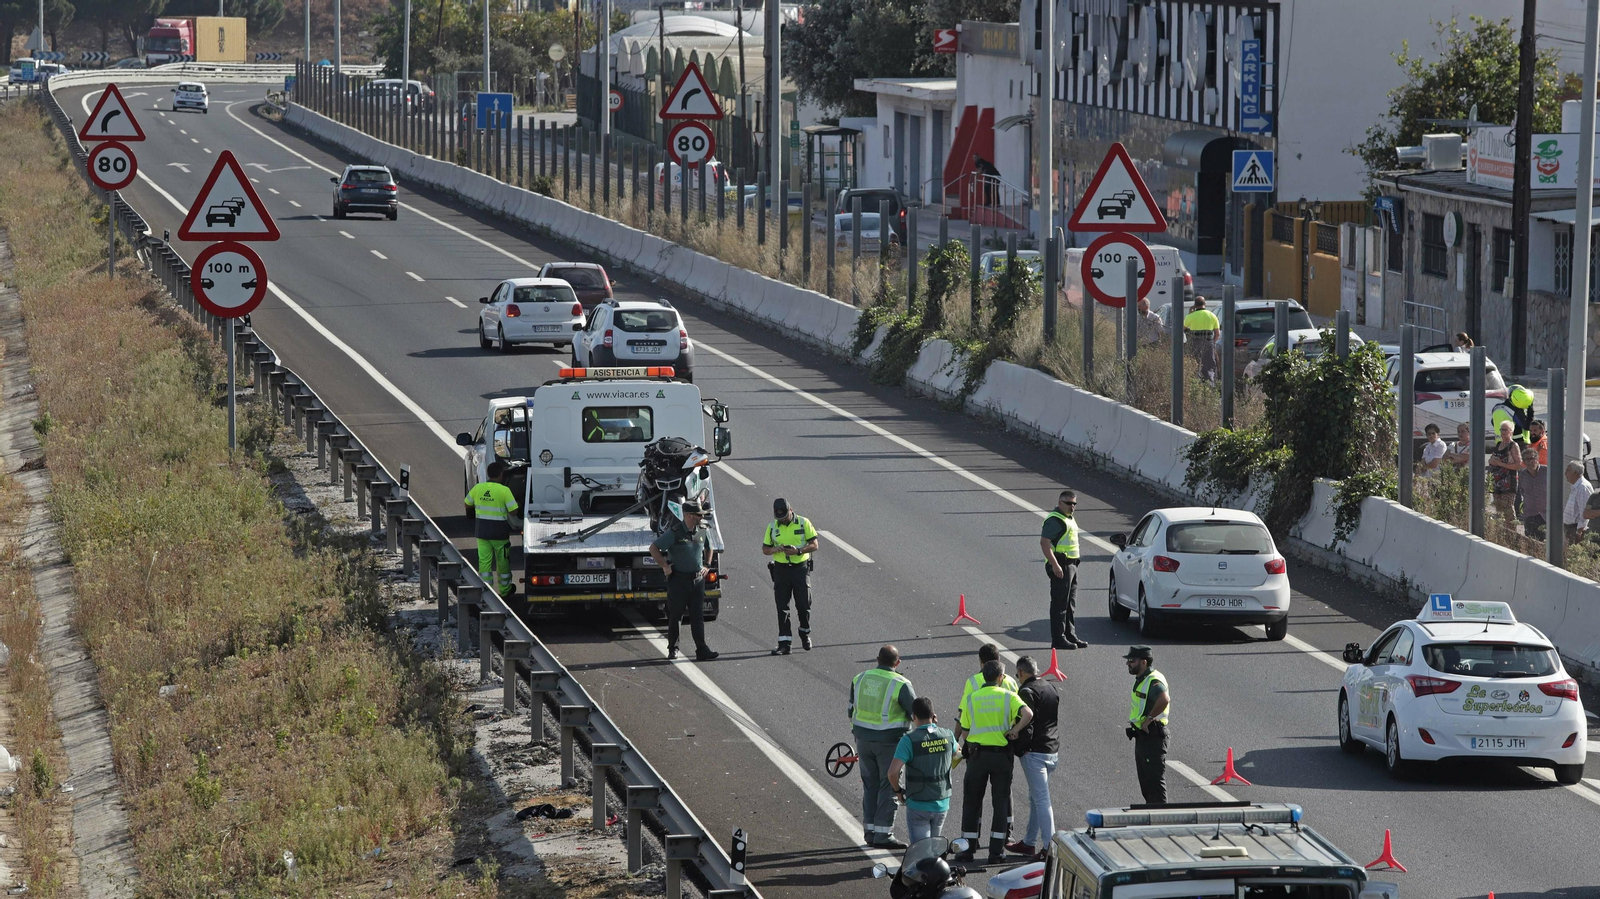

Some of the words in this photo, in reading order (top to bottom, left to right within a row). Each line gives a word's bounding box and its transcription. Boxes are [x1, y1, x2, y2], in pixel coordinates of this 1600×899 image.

[1243, 43, 1257, 114] PARKING
[678, 135, 705, 152] 80
[98, 156, 126, 173] 80
[1098, 253, 1122, 263] 100
[208, 262, 232, 273] 100
[239, 265, 249, 273] m
[593, 368, 641, 377] ASISTENCIA
[586, 389, 650, 399] www.viacar.es
[570, 574, 591, 583] 2020
[592, 574, 608, 582] HGF
[1206, 598, 1226, 607] 9340
[1228, 598, 1243, 607] HDR
[1435, 596, 1447, 610] L
[1466, 684, 1487, 698] La
[921, 738, 949, 748] GUARDIA
[1478, 738, 1504, 748] 2115
[1506, 739, 1526, 748] JTH
